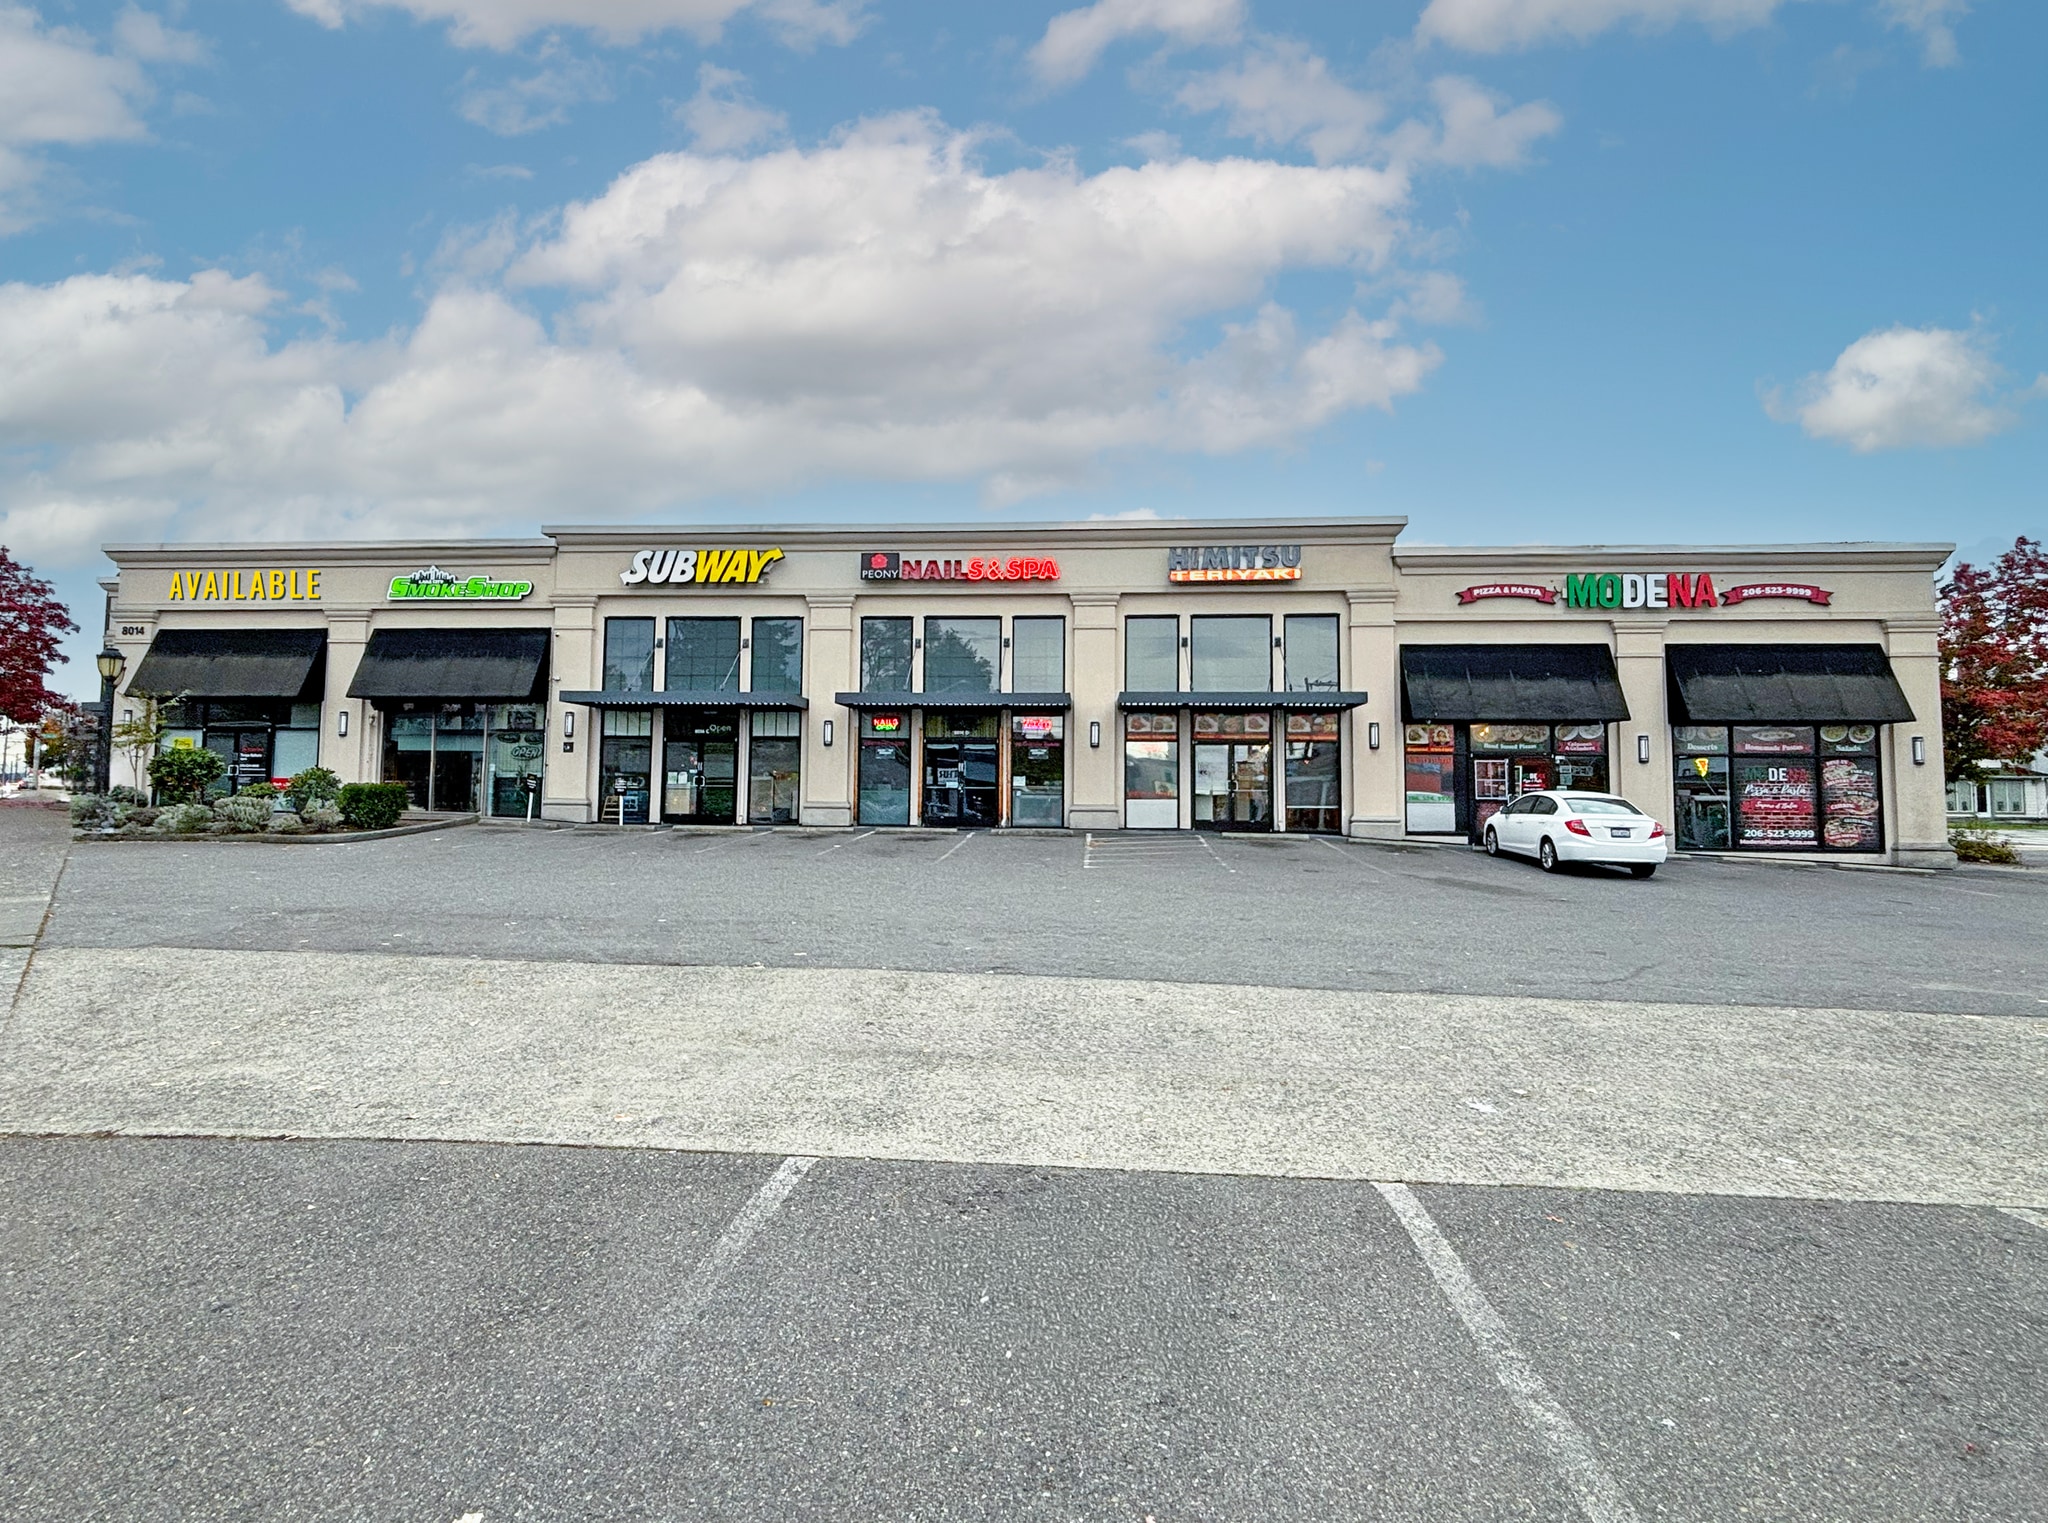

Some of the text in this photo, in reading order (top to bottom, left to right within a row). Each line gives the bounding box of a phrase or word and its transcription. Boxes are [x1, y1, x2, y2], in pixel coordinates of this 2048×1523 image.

[1169, 545, 1301, 570] HIMITSU
[620, 548, 785, 585] SUBWAY
[861, 569, 898, 579] PEONY
[1170, 569, 1301, 581] TERIYAKI
[168, 570, 321, 600] AVAILABLE
[1566, 573, 1718, 609] MODENA
[1473, 587, 1502, 596] PIZZA
[1511, 587, 1542, 596] PASTA
[1742, 586, 1812, 597] 206-523-9999
[121, 626, 145, 636] 8014
[512, 746, 539, 758] OPEN
[1687, 743, 1718, 751] Desserts
[1744, 783, 1769, 796] Pizza
[1781, 783, 1807, 796] Pasta
[1744, 829, 1815, 838] 206-523-9999
